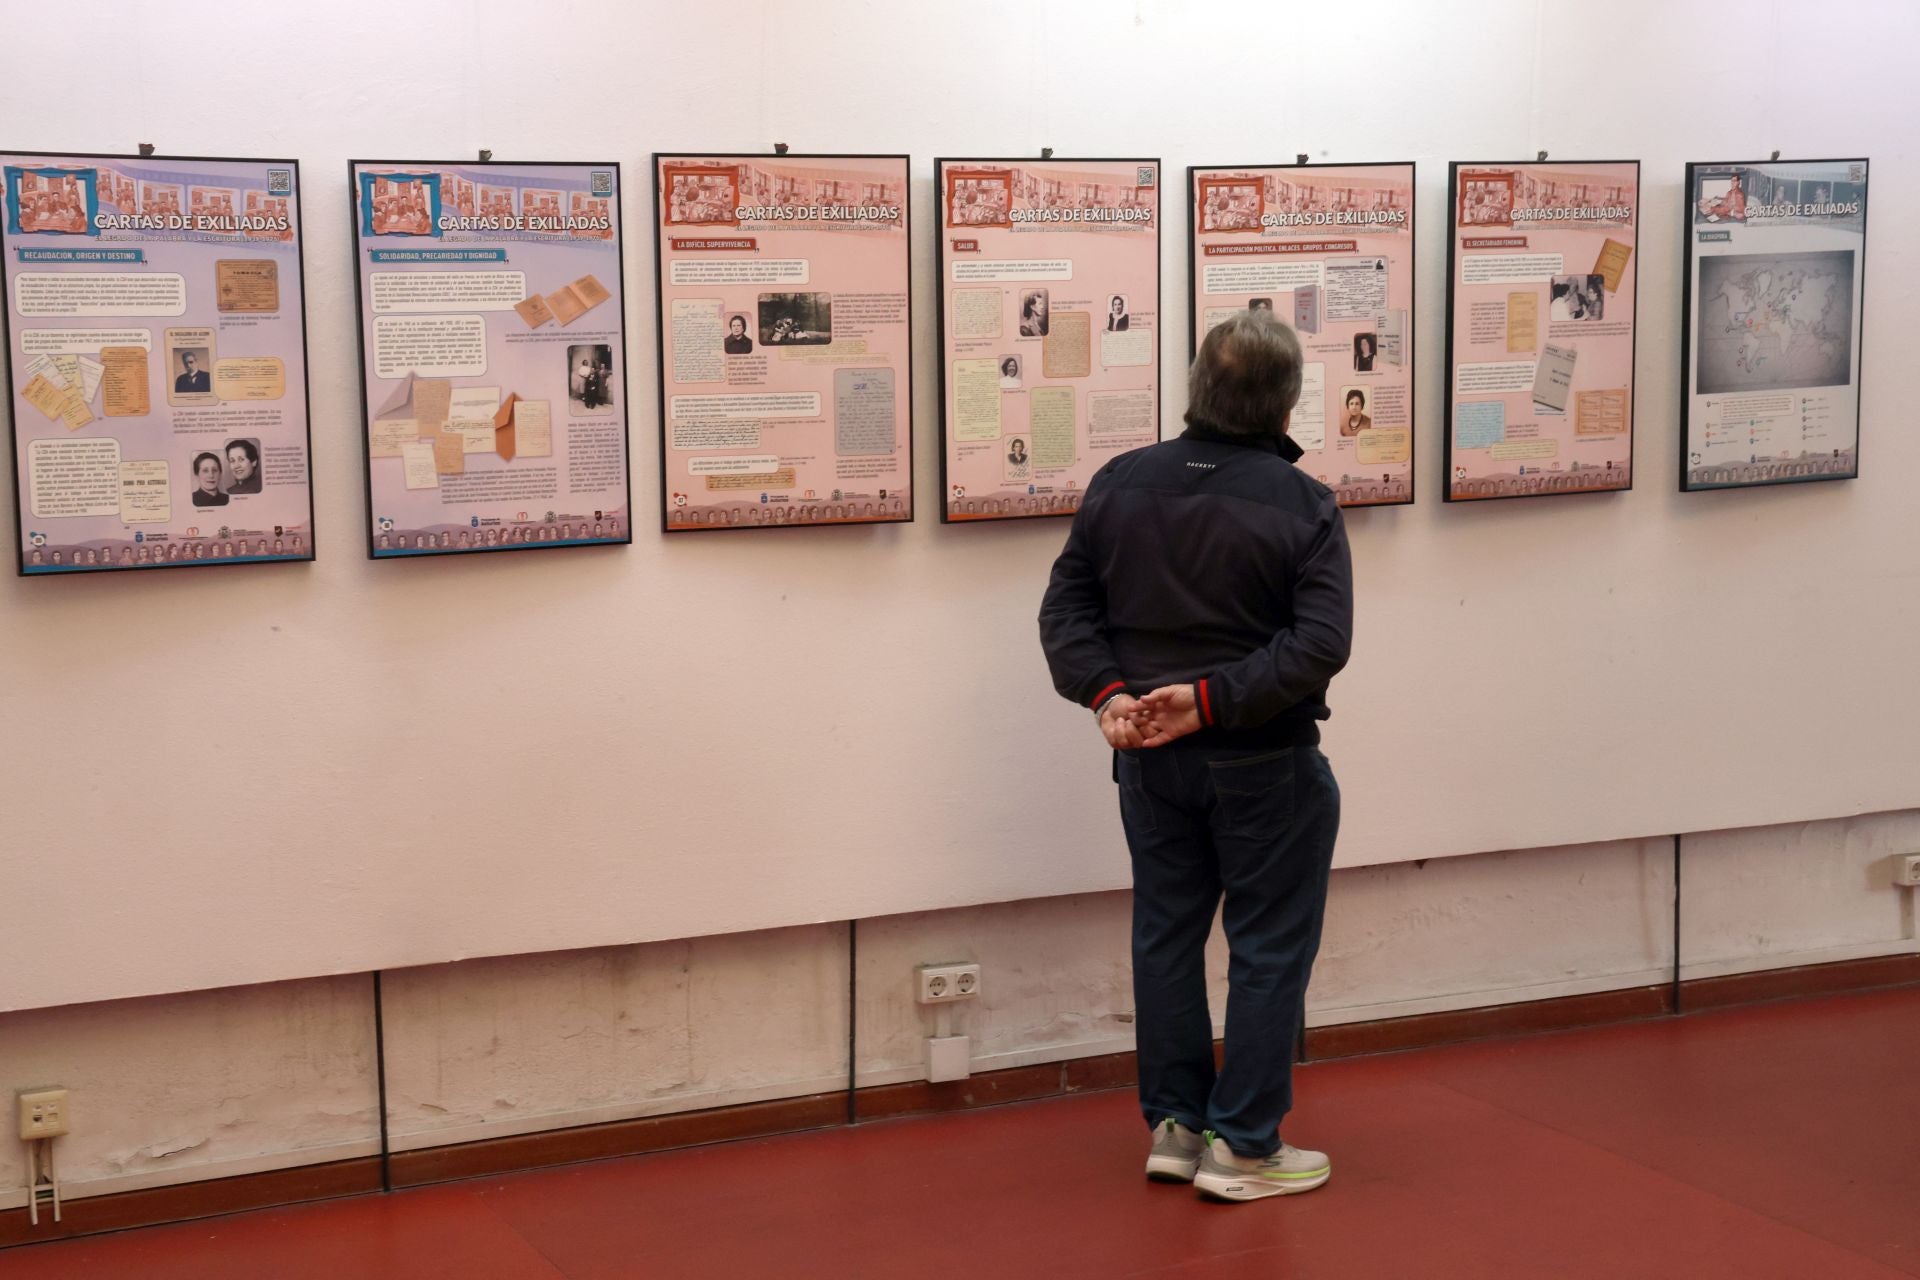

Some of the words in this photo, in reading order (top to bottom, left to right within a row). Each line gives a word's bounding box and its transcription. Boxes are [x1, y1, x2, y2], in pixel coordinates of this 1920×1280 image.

[735, 205, 794, 221] CARTAS
[797, 205, 818, 220] DE
[821, 205, 899, 220] EXILIADAS
[1008, 209, 1061, 222] CARTAS
[1063, 209, 1081, 222] DE
[1084, 208, 1151, 222] EXILIADAS
[1510, 209, 1553, 221] CARTAS
[1555, 208, 1571, 220] DE
[1573, 206, 1631, 219] EXILIADAS
[1744, 204, 1786, 218] CARTAS
[1788, 203, 1802, 217] DE
[1804, 201, 1859, 216] EXILIADAS
[93, 214, 165, 231] CARTAS
[168, 215, 194, 231] DE
[197, 215, 289, 231] EXILIADAS
[437, 216, 501, 231] CARTAS
[503, 216, 526, 231] DE
[528, 216, 610, 231] EXILIADAS
[1260, 213, 1312, 226] CARTAS
[1315, 212, 1334, 225] DE
[1337, 210, 1406, 225] EXILIADAS
[706, 240, 751, 248] SUPERVIVENCIA
[957, 242, 975, 250] SALUD
[76, 252, 101, 260] ORIGEN
[102, 252, 107, 260] Y
[107, 252, 136, 260] DESTINO
